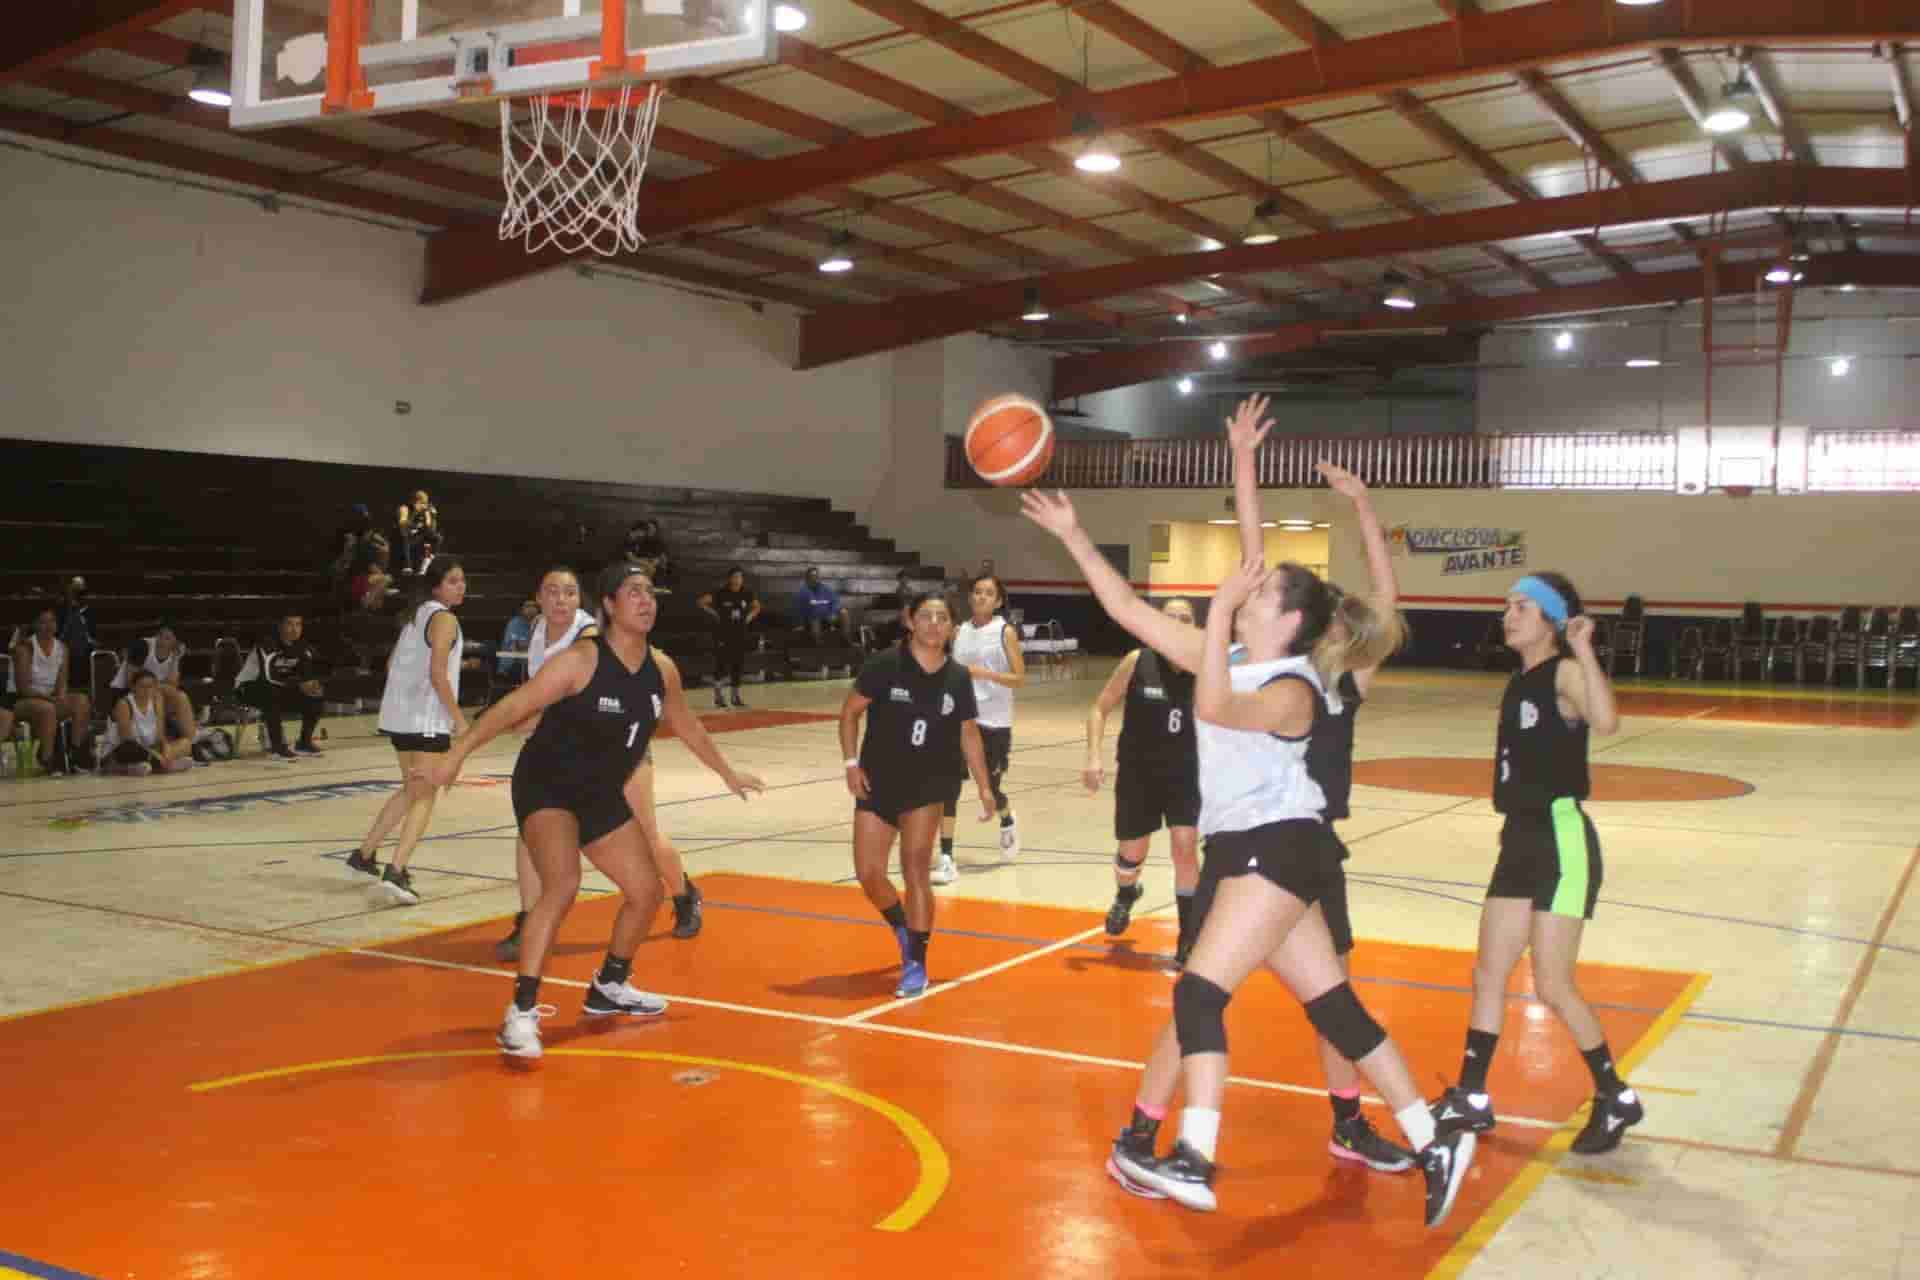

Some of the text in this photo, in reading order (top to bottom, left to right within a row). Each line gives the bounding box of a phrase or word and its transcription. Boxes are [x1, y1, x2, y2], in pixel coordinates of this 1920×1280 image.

[1441, 547, 1523, 573] AVANTE
[911, 719, 928, 746] 8
[1167, 708, 1182, 734] 6
[625, 721, 640, 748] 1
